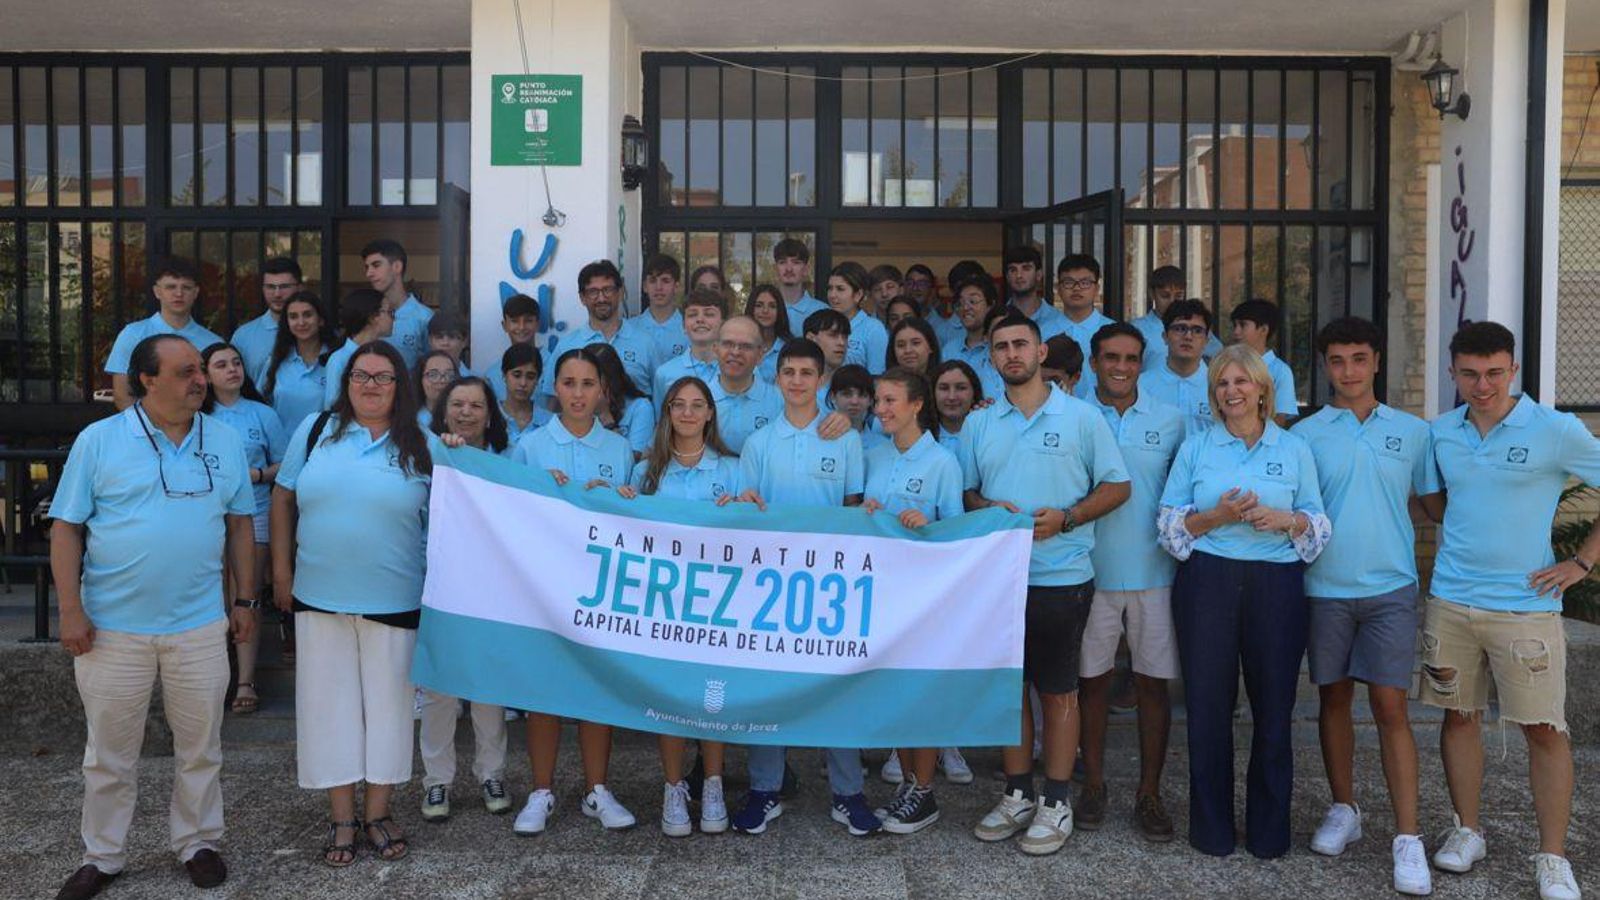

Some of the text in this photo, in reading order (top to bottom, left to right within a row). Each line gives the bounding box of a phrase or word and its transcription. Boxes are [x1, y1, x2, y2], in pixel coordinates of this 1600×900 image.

[588, 525, 873, 572] CANDIDATURA
[577, 544, 874, 638] JEREZ 2031
[573, 609, 868, 658] CAPITAL EUROPEA DE LA CULTURA
[646, 707, 778, 733] Ayuntamiento de Jerez
